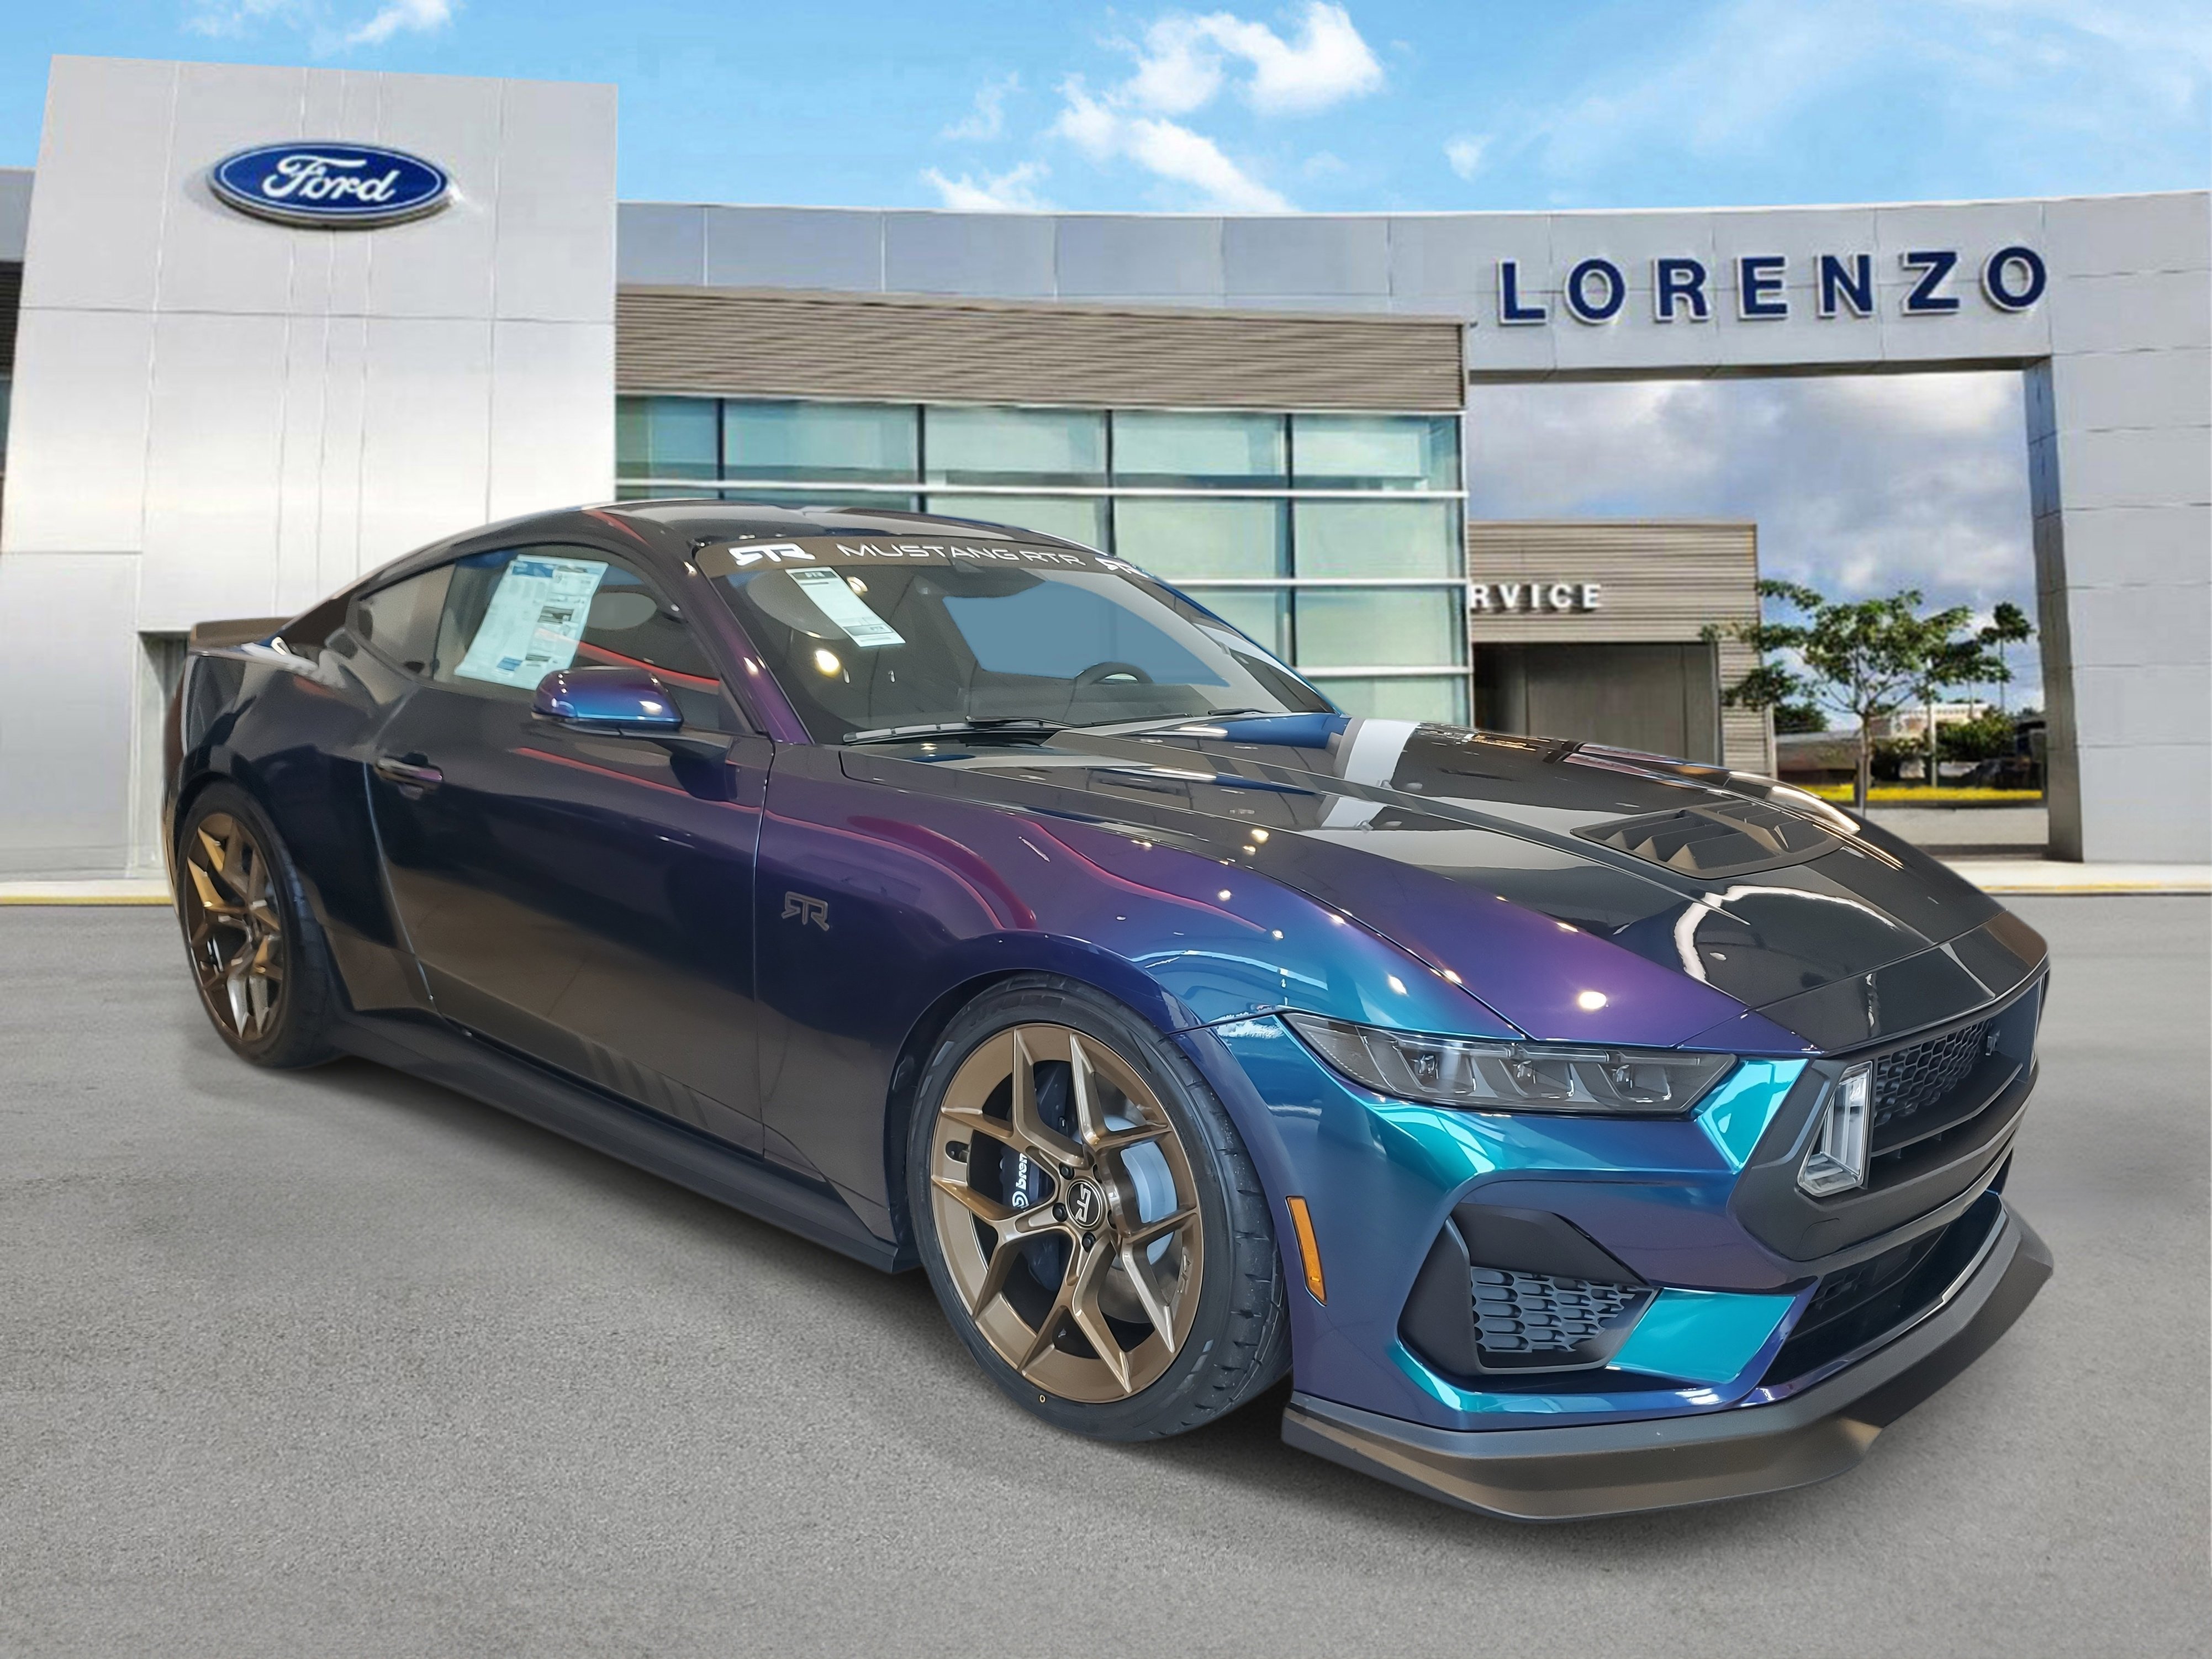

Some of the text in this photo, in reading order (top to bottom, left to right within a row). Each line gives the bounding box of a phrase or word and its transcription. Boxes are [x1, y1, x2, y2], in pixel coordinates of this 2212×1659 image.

[262, 154, 401, 202] Ford
[1497, 246, 2048, 326] LORENZO
[836, 543, 1086, 566] MUSTANG RTR
[1470, 584, 1602, 608] RVICE
[1016, 1153, 1028, 1190] brem
